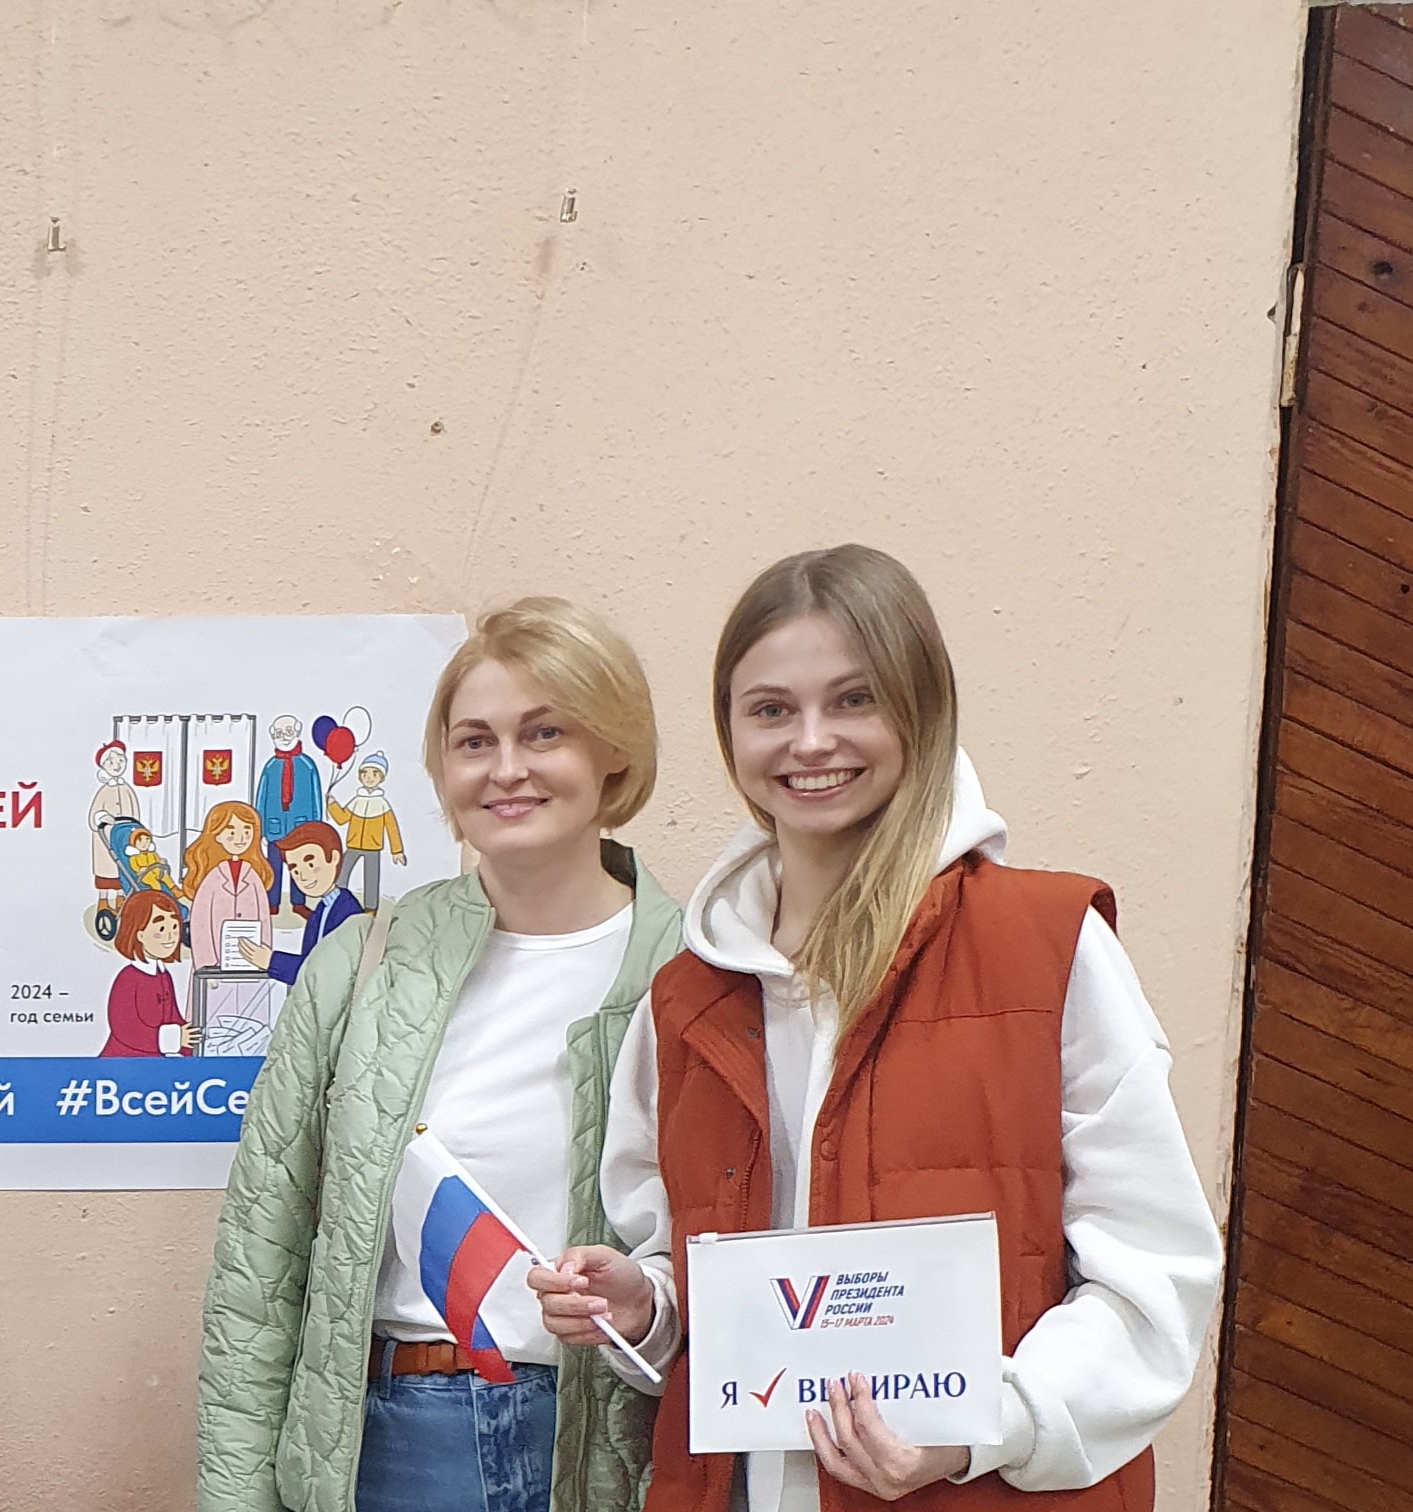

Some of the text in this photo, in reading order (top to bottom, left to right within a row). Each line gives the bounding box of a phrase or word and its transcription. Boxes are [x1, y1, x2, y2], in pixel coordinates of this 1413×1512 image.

[10, 984, 53, 1000] 2024
[10, 1012, 94, 1025] год семьи
[56, 1078, 250, 1116] #ВсейСе
[836, 1271, 890, 1286] ВЫБОРЫ
[830, 1284, 905, 1301] ПРЕЗИДЕНТА
[825, 1301, 874, 1316] РОССИИ
[720, 1371, 967, 1409] Я ВЫИРАЮ
